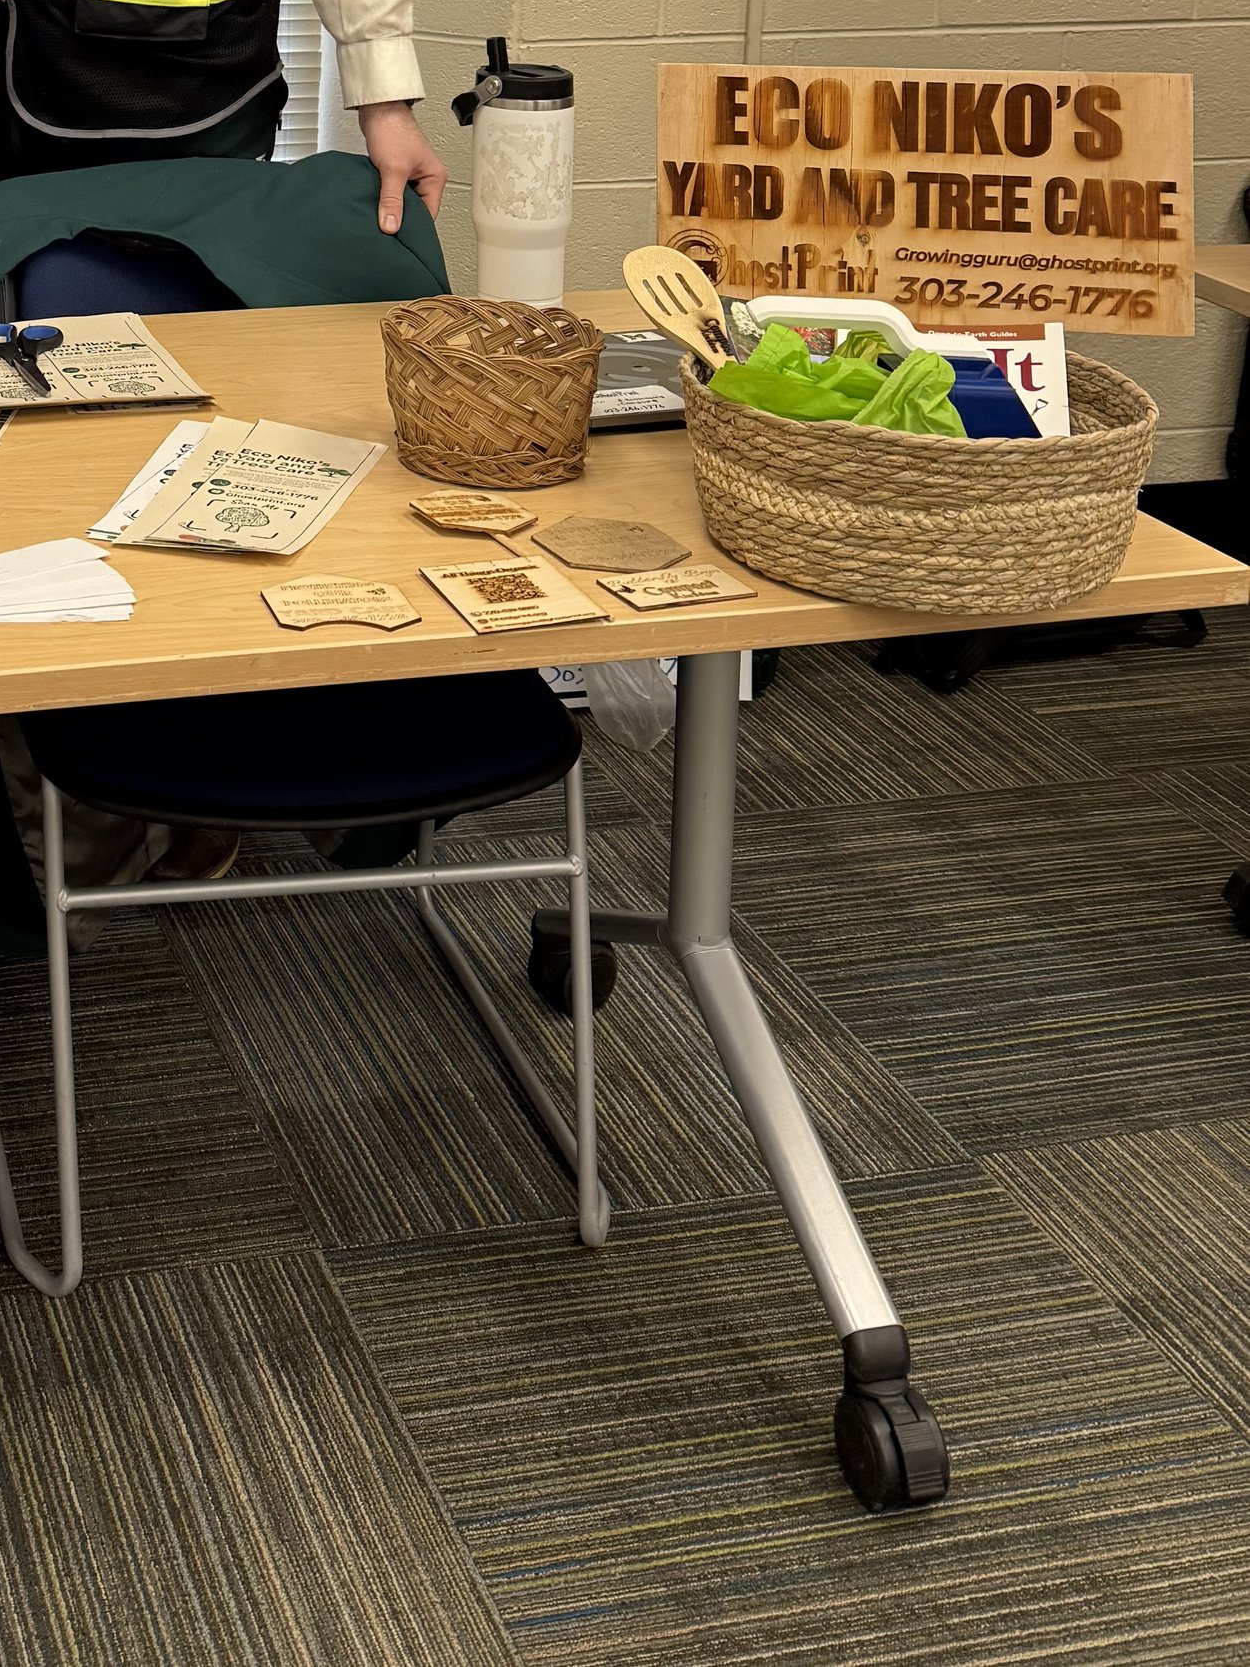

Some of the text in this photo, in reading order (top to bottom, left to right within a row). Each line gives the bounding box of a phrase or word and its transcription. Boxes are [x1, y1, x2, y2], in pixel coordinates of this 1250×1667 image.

[715, 75, 1123, 161] ECO NIKO'S
[663, 160, 1179, 240] YARD AND TREE CARE
[895, 246, 1178, 279] Growingguru@ghostprint.org
[893, 276, 1158, 319] 303-246-1776
[232, 458, 316, 476] Tree Care
[237, 454, 315, 470] Yard and
[240, 448, 332, 468] Eco Niko's
[231, 484, 319, 501] 303-246-1776
